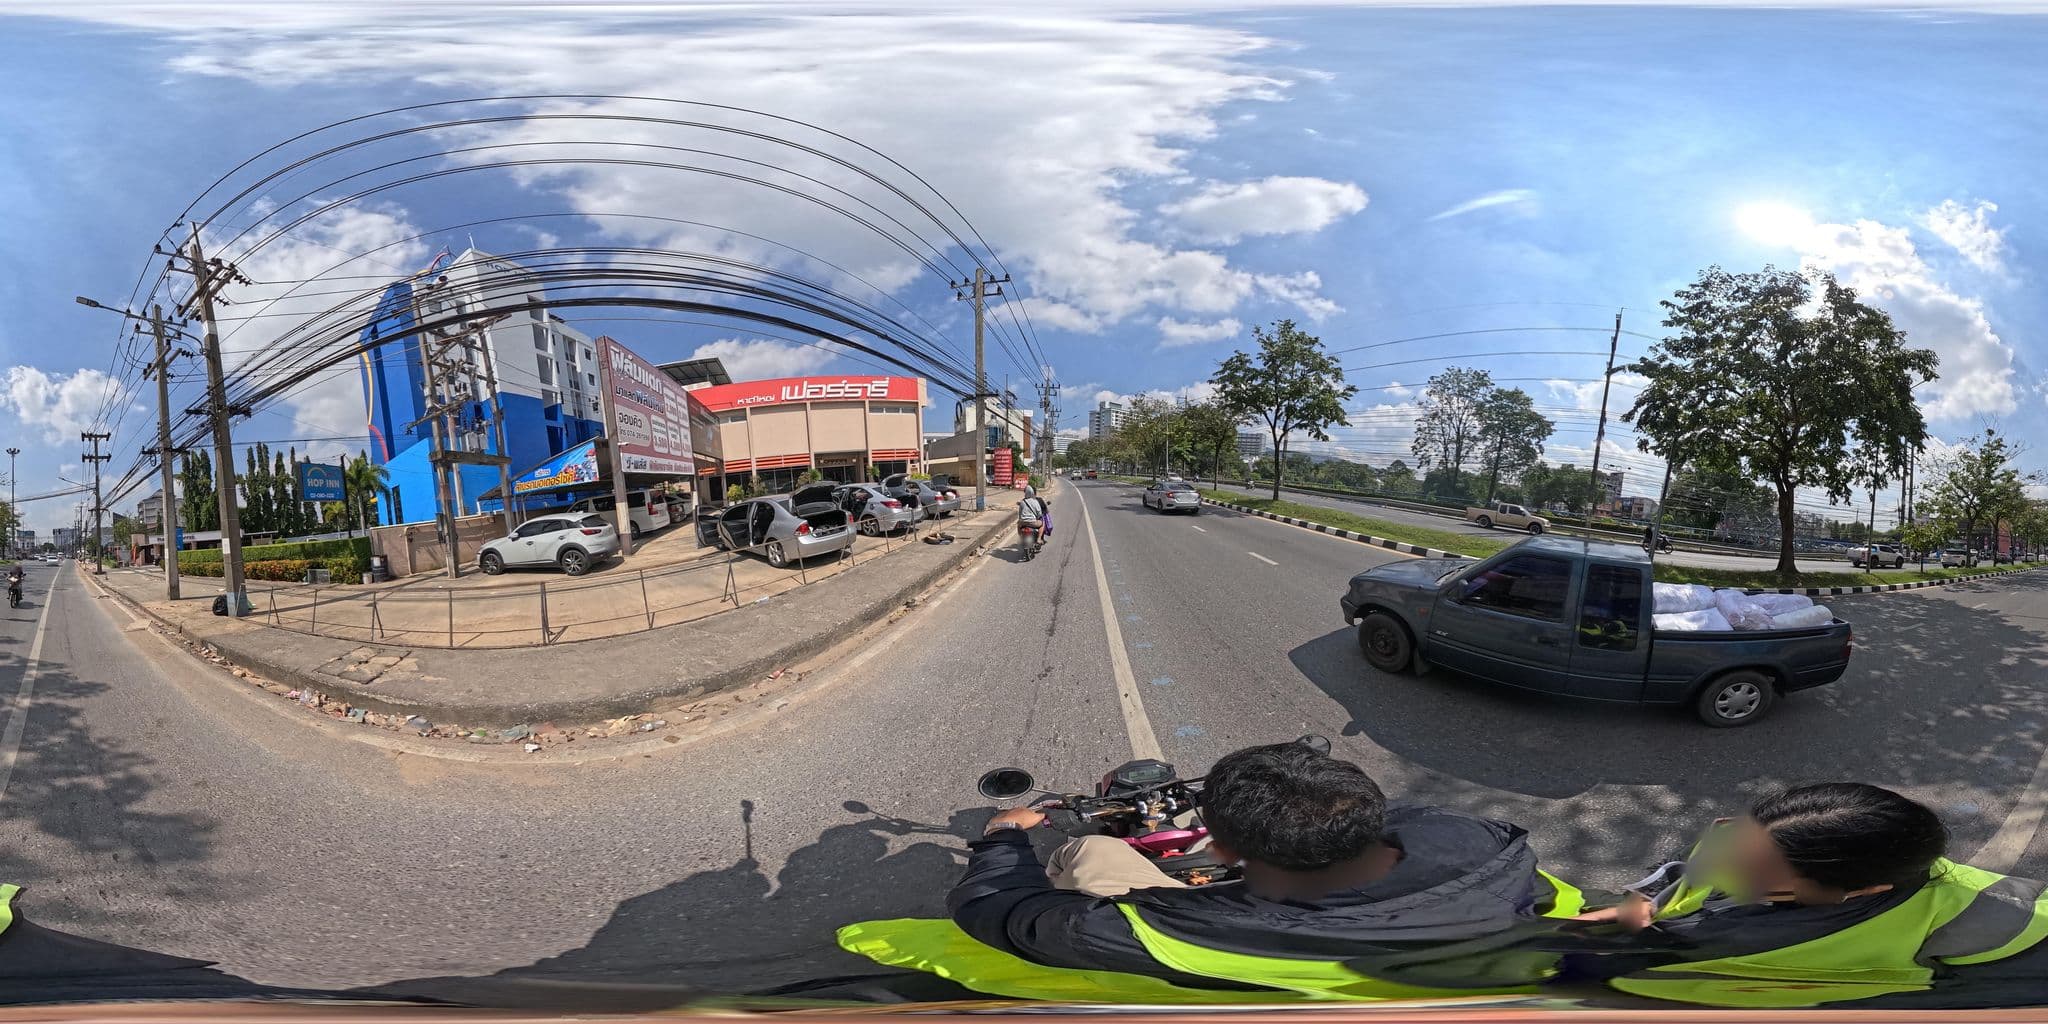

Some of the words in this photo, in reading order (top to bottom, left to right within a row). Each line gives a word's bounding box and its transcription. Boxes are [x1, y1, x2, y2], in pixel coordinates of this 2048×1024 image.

[610, 345, 663, 395] ฟิล์มแตก
[618, 412, 643, 429] จองคิว
[307, 478, 325, 487] HOP
[326, 479, 340, 488] INN
